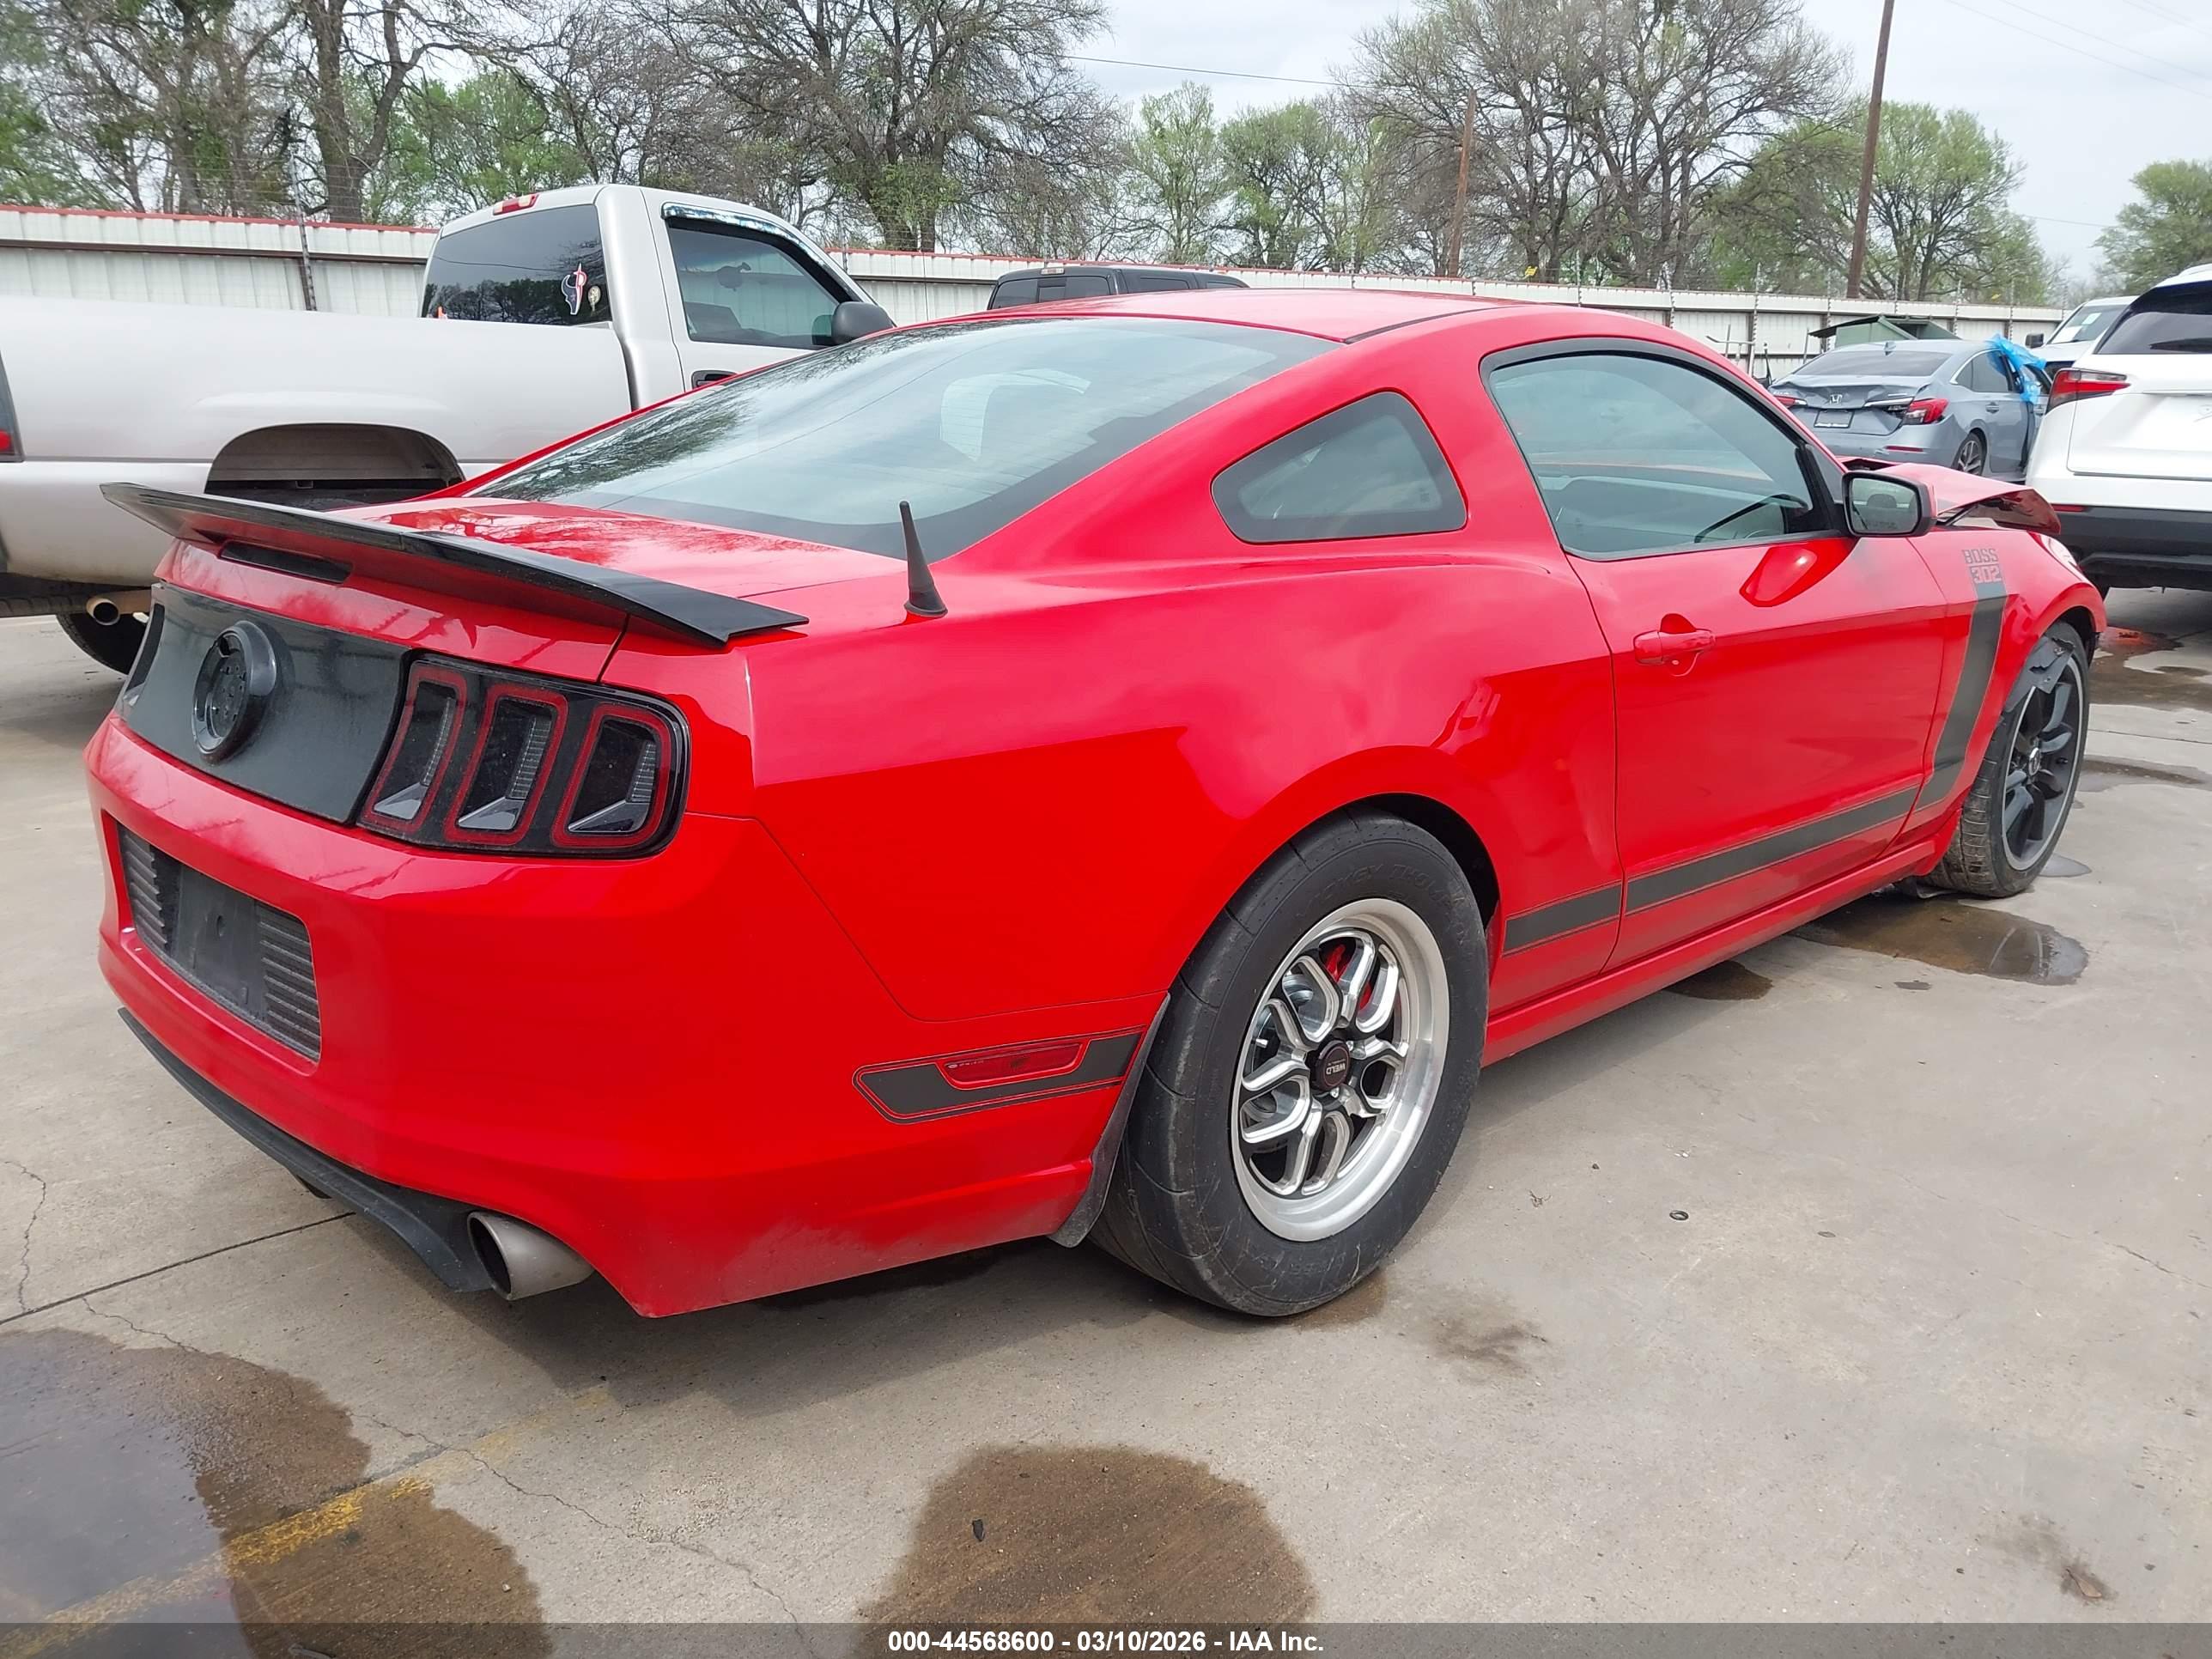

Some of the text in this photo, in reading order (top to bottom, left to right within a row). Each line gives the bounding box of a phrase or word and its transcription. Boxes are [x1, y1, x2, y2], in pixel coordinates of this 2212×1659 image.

[1961, 548, 1999, 564] BOSS
[1970, 566, 2002, 584] 302
[1326, 1062, 1346, 1075] WELD
